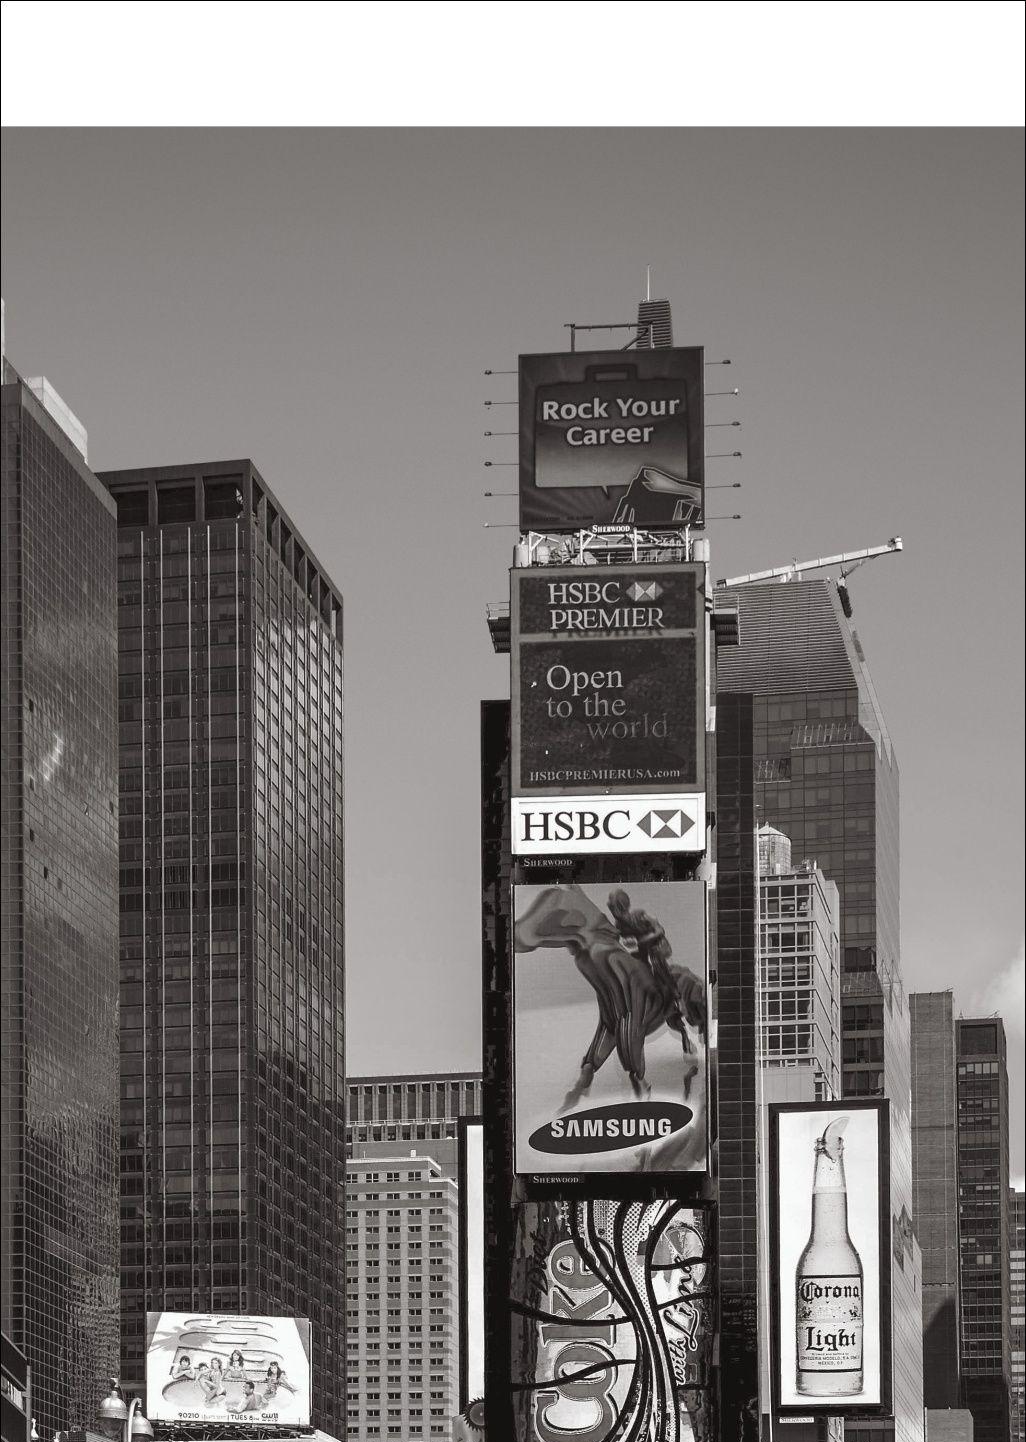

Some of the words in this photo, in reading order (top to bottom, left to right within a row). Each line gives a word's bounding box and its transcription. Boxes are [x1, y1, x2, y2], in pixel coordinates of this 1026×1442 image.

[542, 398, 608, 421] Rock
[616, 398, 680, 417] Your
[566, 426, 654, 446] Career
[547, 581, 621, 604] HSBC
[549, 608, 665, 630] PREMIER
[546, 665, 623, 696] Open
[546, 697, 573, 718] to
[583, 691, 627, 717] the
[586, 713, 668, 741] world
[529, 768, 681, 781] HSBCPREMIERUSA.com
[520, 810, 631, 842] HSBC
[551, 1118, 672, 1138] SAMSUNG
[801, 1281, 860, 1303] Corona
[805, 1326, 856, 1351] Light
